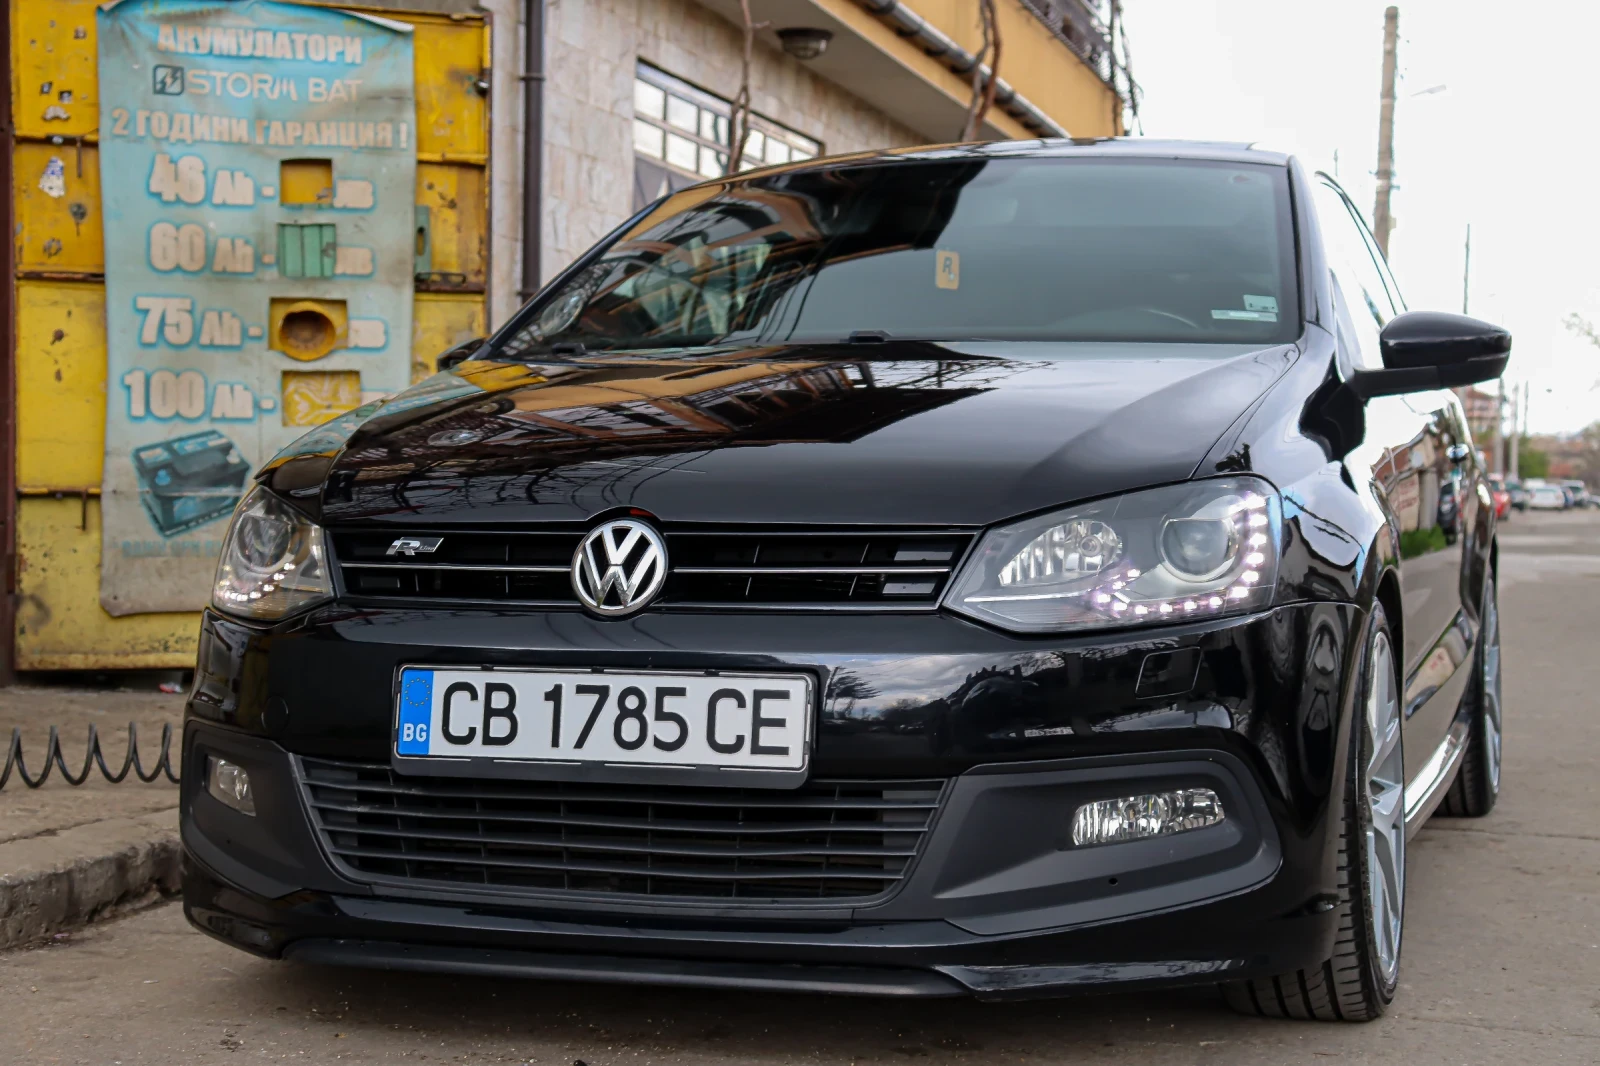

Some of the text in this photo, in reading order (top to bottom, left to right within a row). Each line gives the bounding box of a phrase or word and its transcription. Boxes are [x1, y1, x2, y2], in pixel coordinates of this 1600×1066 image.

[156, 23, 363, 65] АКУМУЛАТОРИ
[308, 77, 363, 103] BAT
[111, 108, 130, 136] 2
[136, 109, 250, 144] ГОДИНИ
[254, 118, 393, 149] ГАРАНЦИЯ
[149, 221, 206, 272] 60
[135, 297, 194, 346] 75
[123, 369, 206, 419] 100
[402, 722, 428, 742] BG
[440, 680, 792, 757] CB 1785 CE
